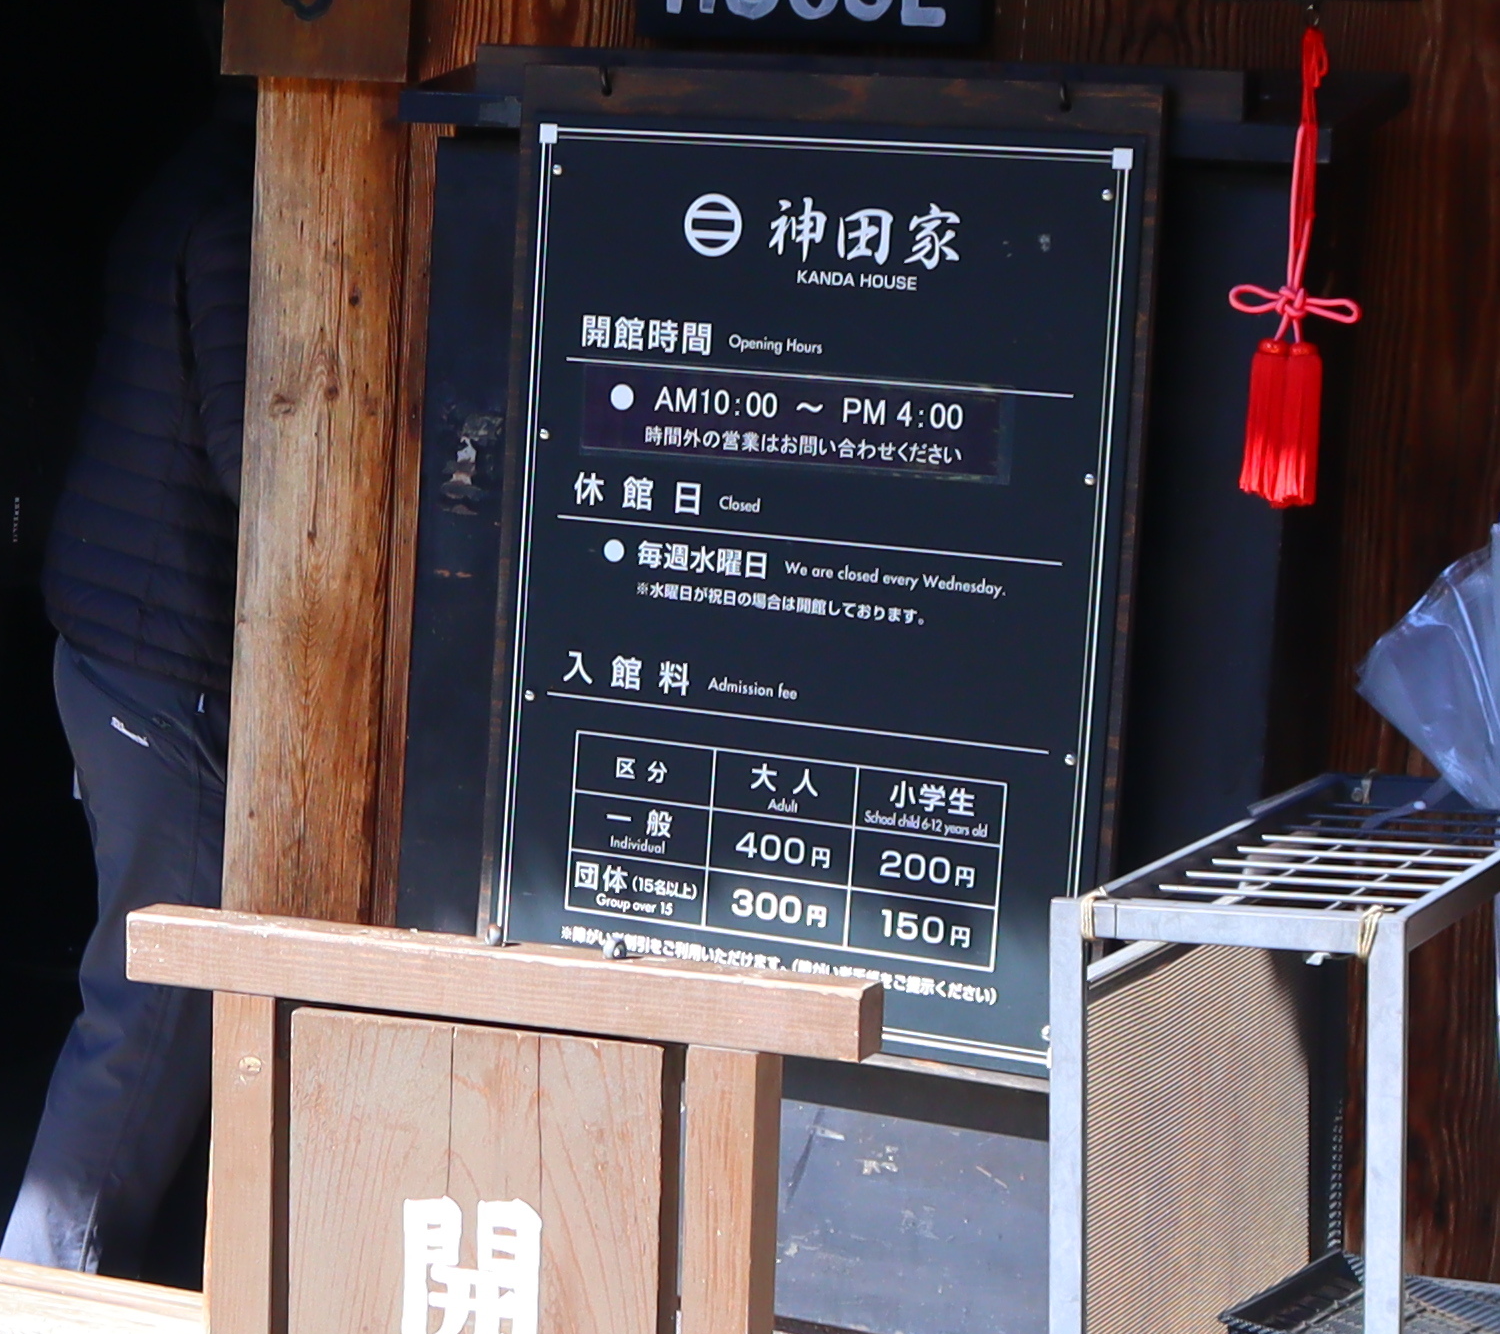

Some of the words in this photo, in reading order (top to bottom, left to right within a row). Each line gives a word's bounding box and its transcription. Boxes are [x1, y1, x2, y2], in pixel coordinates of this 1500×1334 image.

[767, 196, 961, 270] 神田家
[796, 270, 855, 286] KANDA
[859, 274, 917, 290] HOUSE
[581, 314, 713, 356] 開館時間
[728, 334, 783, 355] Opening
[786, 338, 822, 354] Hours
[654, 387, 777, 417] AM10:00
[842, 397, 885, 424] PM
[896, 401, 963, 429] 4:00
[643, 424, 963, 465] 時間外の営業はお問い合わせください
[573, 471, 702, 516] 休館日
[718, 496, 761, 513] Closed
[636, 540, 768, 579] 毎週水曜日
[784, 560, 807, 576] We
[811, 567, 833, 578] are
[837, 565, 879, 583] closed
[882, 574, 919, 590] every
[562, 650, 690, 697] 入館料
[707, 677, 773, 696] Admission
[778, 682, 797, 699] fee
[615, 756, 668, 784] 区分
[750, 763, 819, 797] 大人
[767, 797, 798, 813] Adult
[888, 781, 976, 817] 小学生
[606, 809, 673, 839] 一般
[864, 810, 896, 825] School
[897, 813, 920, 829] child
[920, 817, 942, 832] 6-12
[943, 824, 970, 835] years
[971, 823, 988, 838] old
[609, 835, 666, 855] Individual
[735, 830, 832, 869] 400円
[879, 849, 976, 889] 200円
[595, 893, 631, 912] Group
[632, 901, 657, 913] over
[660, 901, 673, 916] 15
[730, 888, 828, 928] 300円
[881, 909, 972, 949] 150円
